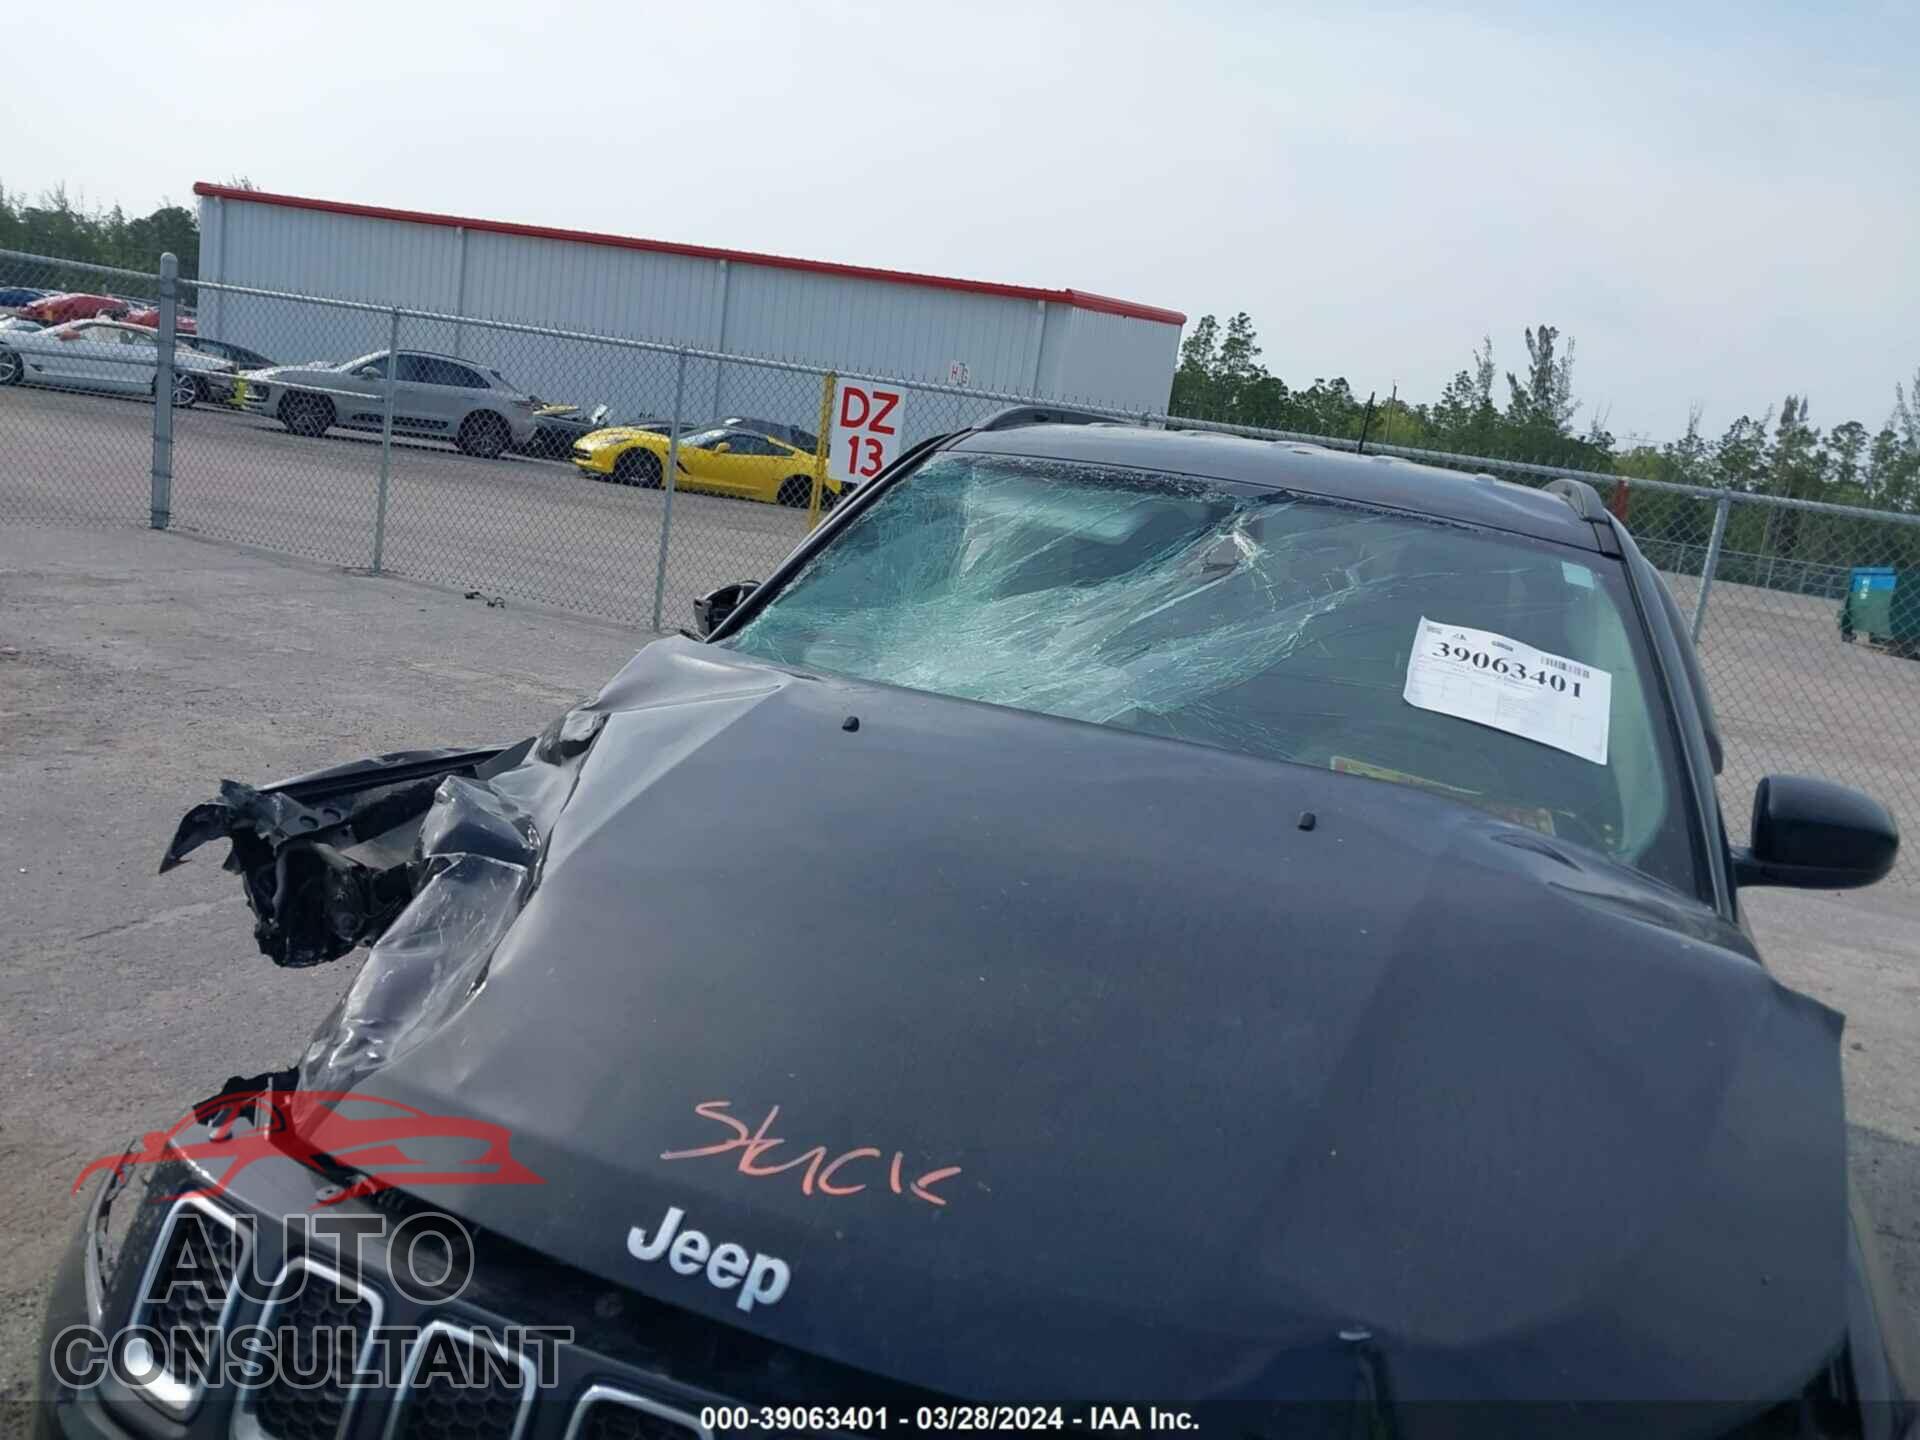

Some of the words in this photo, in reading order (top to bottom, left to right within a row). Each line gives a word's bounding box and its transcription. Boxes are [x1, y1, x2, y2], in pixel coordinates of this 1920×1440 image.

[840, 387, 899, 435] DZ
[848, 436, 883, 477] 13
[1432, 642, 1582, 698] 39063401
[627, 1206, 791, 1312] Jeep
